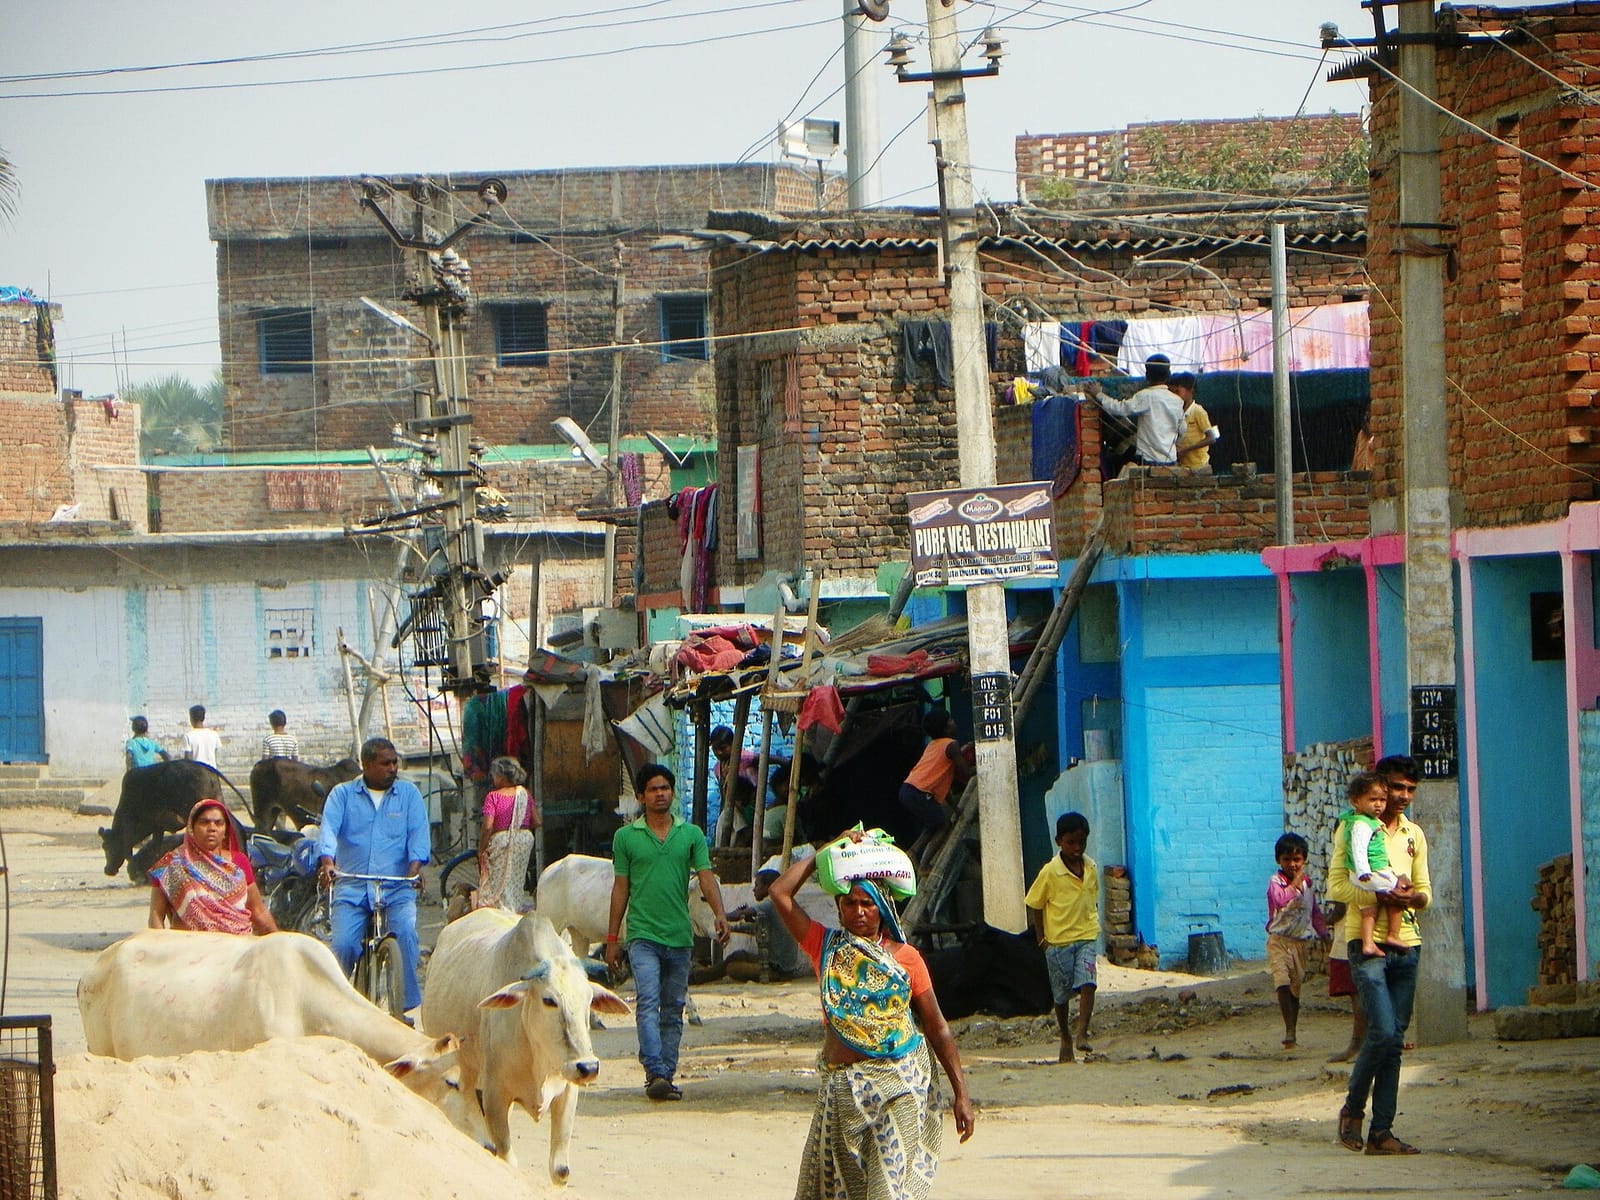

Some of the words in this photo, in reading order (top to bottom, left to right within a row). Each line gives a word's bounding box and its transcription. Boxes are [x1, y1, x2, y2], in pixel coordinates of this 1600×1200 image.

[915, 527, 947, 557] PURE
[947, 524, 975, 553] VEG.
[976, 519, 1051, 551] RESTAURANT
[980, 678, 997, 690] GYA
[984, 693, 996, 705] 13
[1421, 690, 1442, 706] GYA
[984, 707, 1001, 721] F01
[1424, 712, 1440, 728] 13
[1423, 734, 1446, 751] F01
